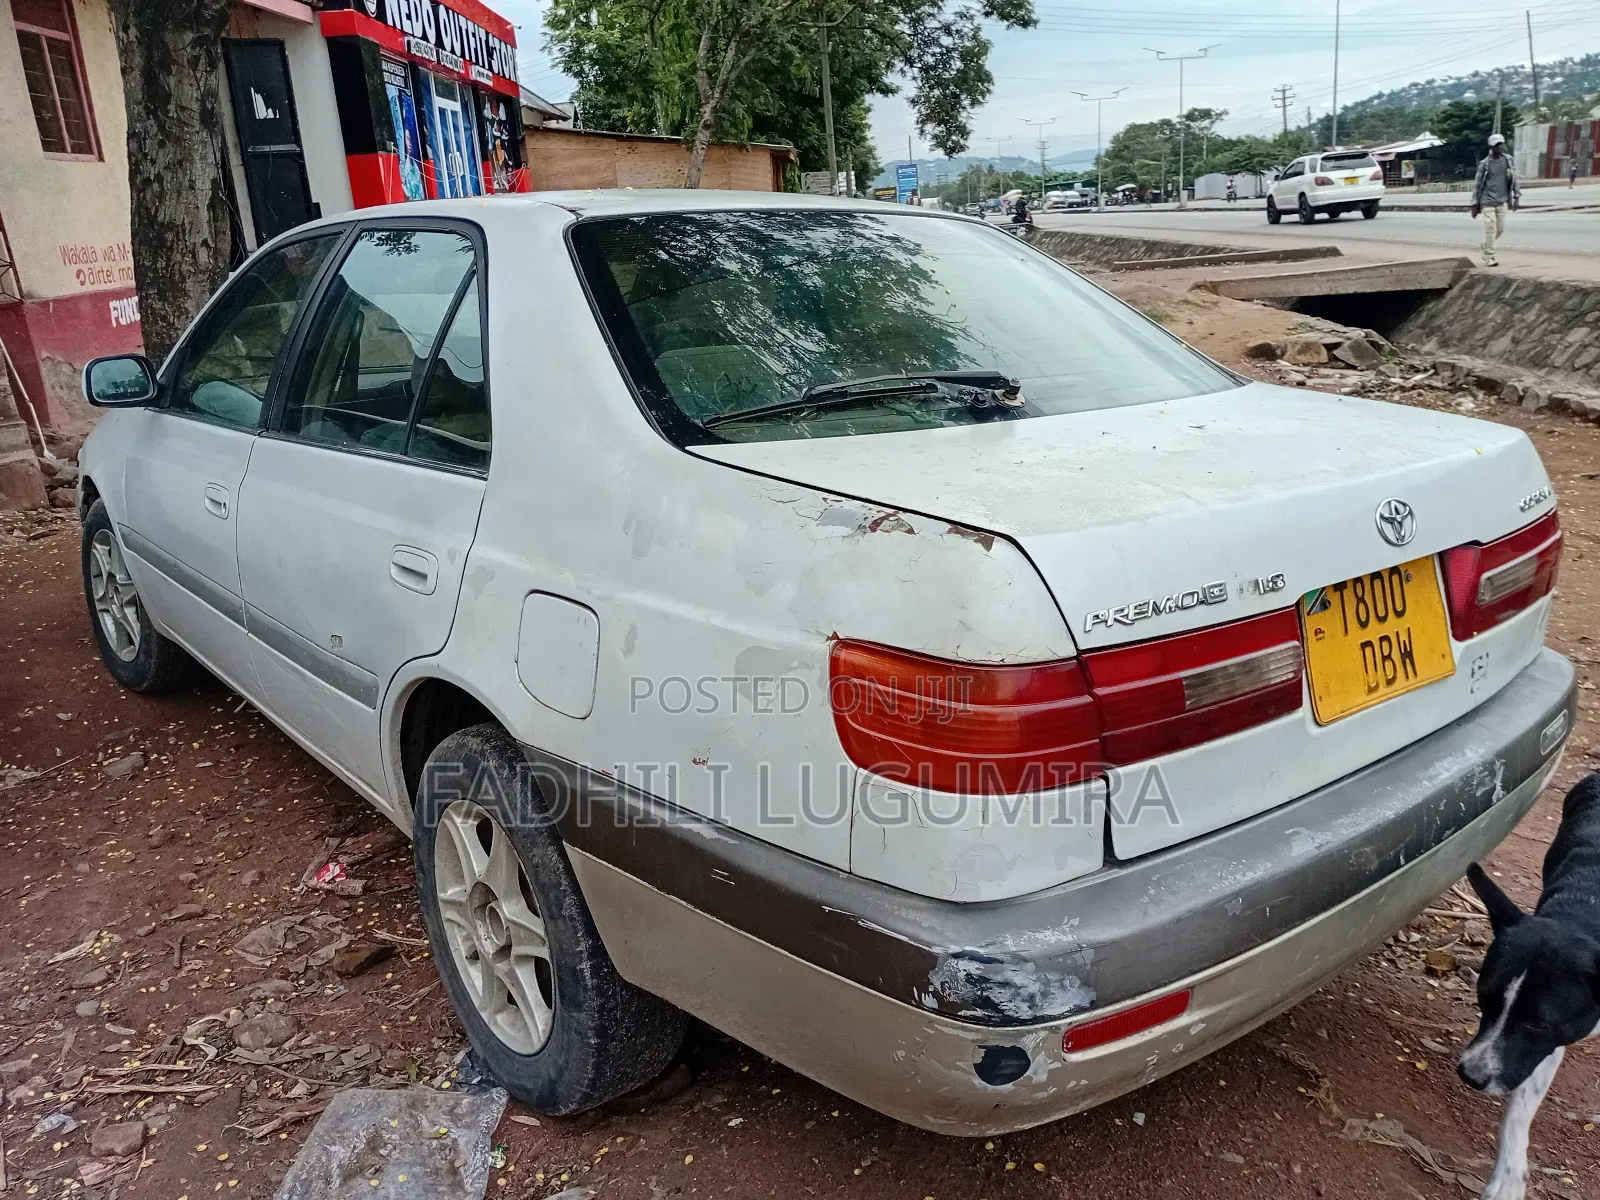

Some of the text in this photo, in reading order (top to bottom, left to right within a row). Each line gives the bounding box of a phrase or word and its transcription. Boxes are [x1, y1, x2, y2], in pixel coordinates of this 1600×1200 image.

[385, 0, 436, 45] NEDO
[438, 4, 489, 69] OUTFIT
[59, 243, 98, 266] Wakala
[100, 245, 116, 262] wa
[88, 265, 116, 285] airtel
[1084, 589, 1201, 633] PREMIO
[1333, 566, 1407, 636] T800
[1360, 626, 1418, 694] DBW
